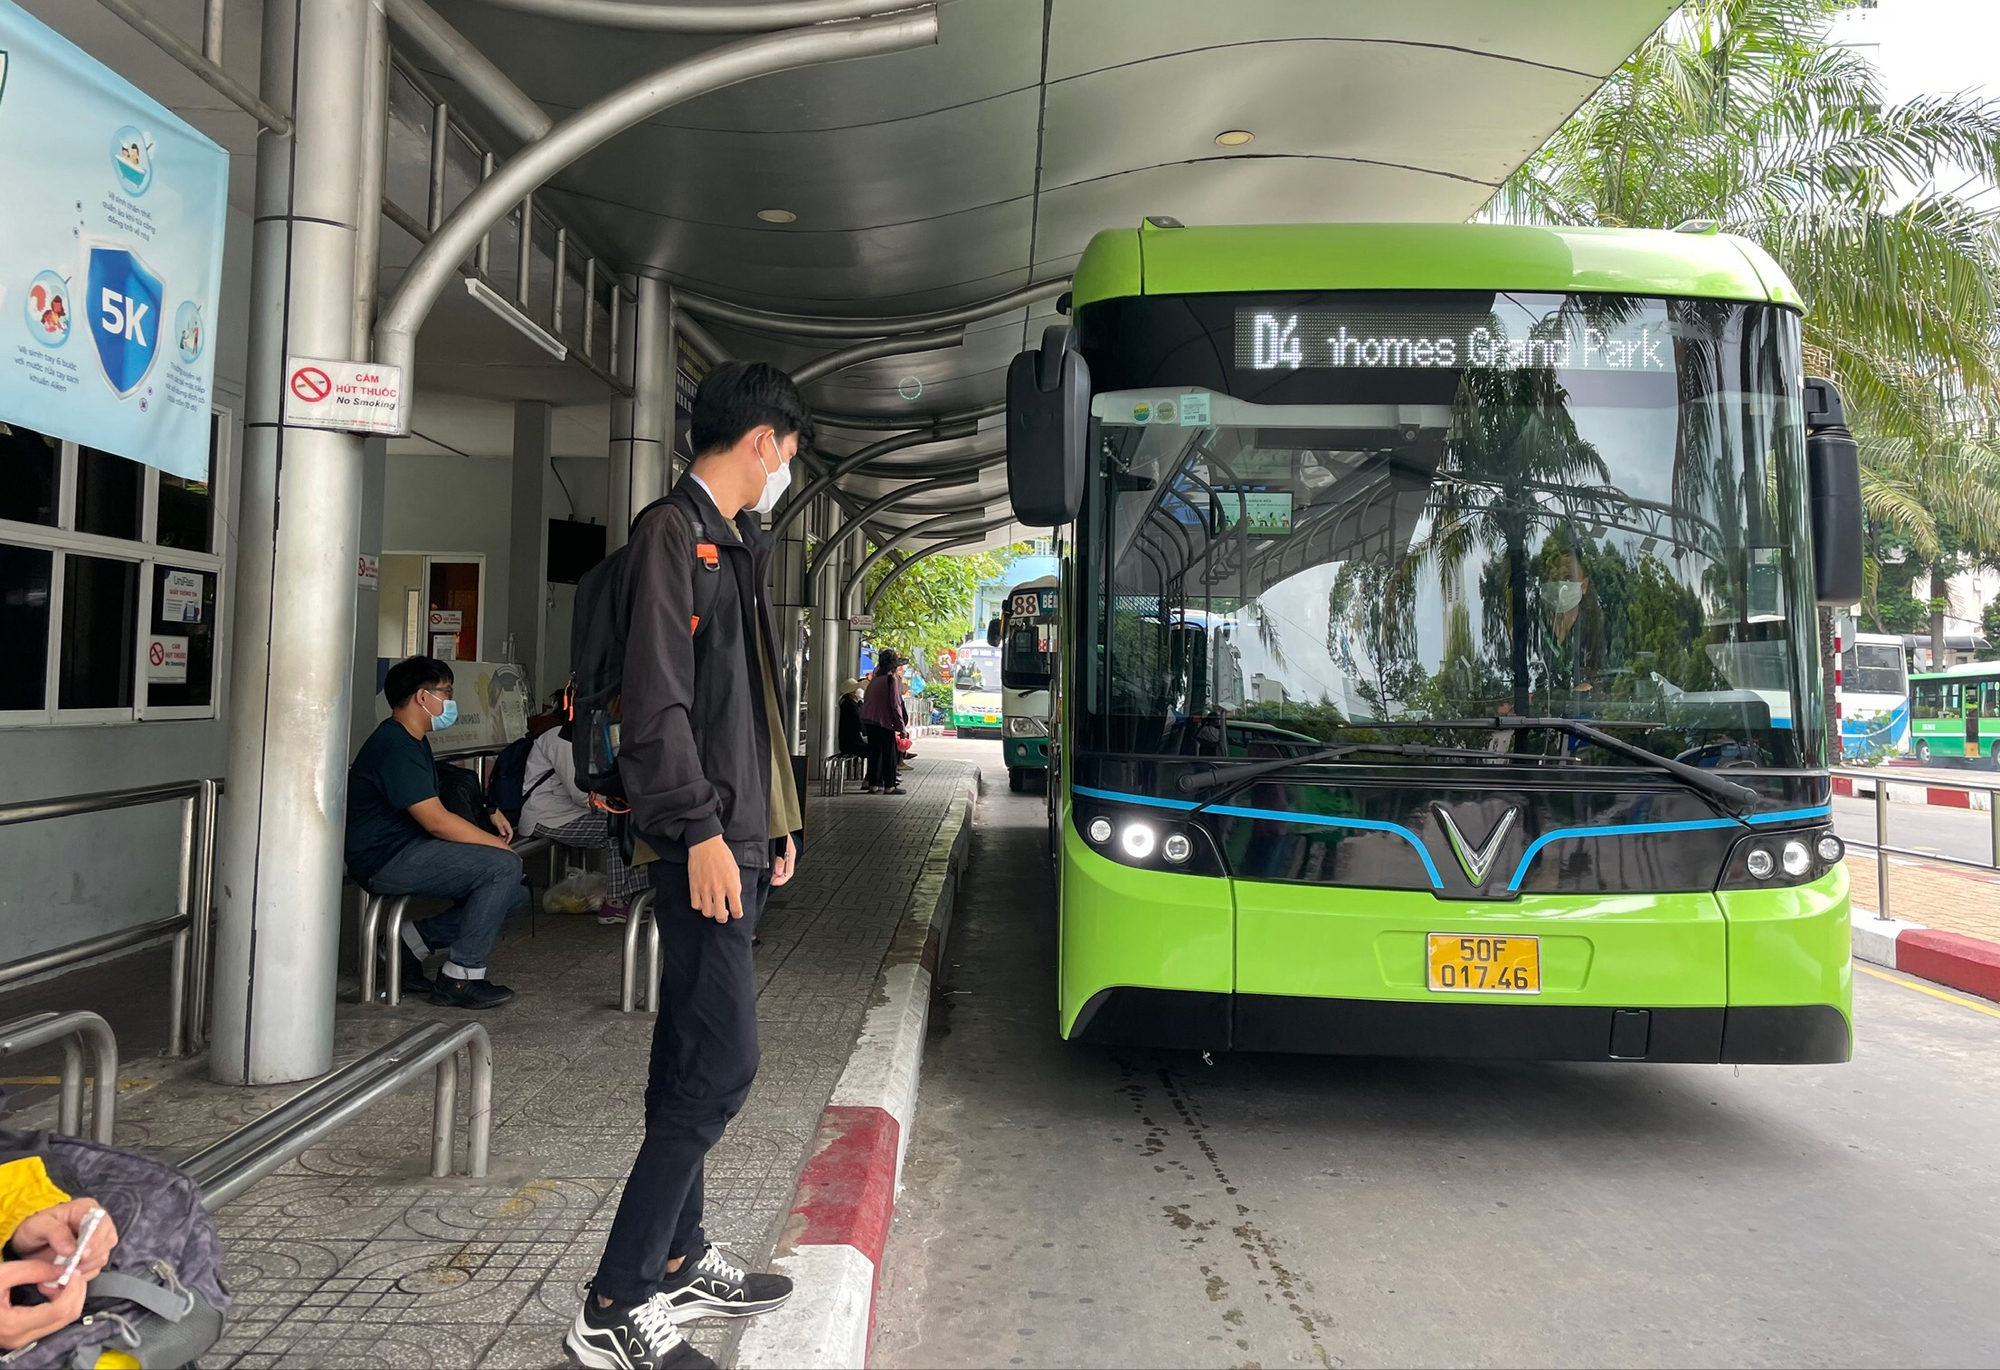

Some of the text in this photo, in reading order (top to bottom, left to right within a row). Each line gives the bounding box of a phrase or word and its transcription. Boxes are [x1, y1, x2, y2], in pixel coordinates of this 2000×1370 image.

[102, 287, 149, 347] 5K
[1254, 314, 1302, 368] D4
[1471, 327, 1570, 367] Grand
[1584, 328, 1664, 368] Park
[56, 357, 61, 365] 6
[355, 372, 379, 383] CẤM
[336, 384, 397, 398] HÚT THUỐC
[336, 397, 396, 411] No Smoking
[1014, 595, 1037, 616] 88
[1460, 939, 1507, 962] 50F
[1441, 964, 1528, 990] 017.46
